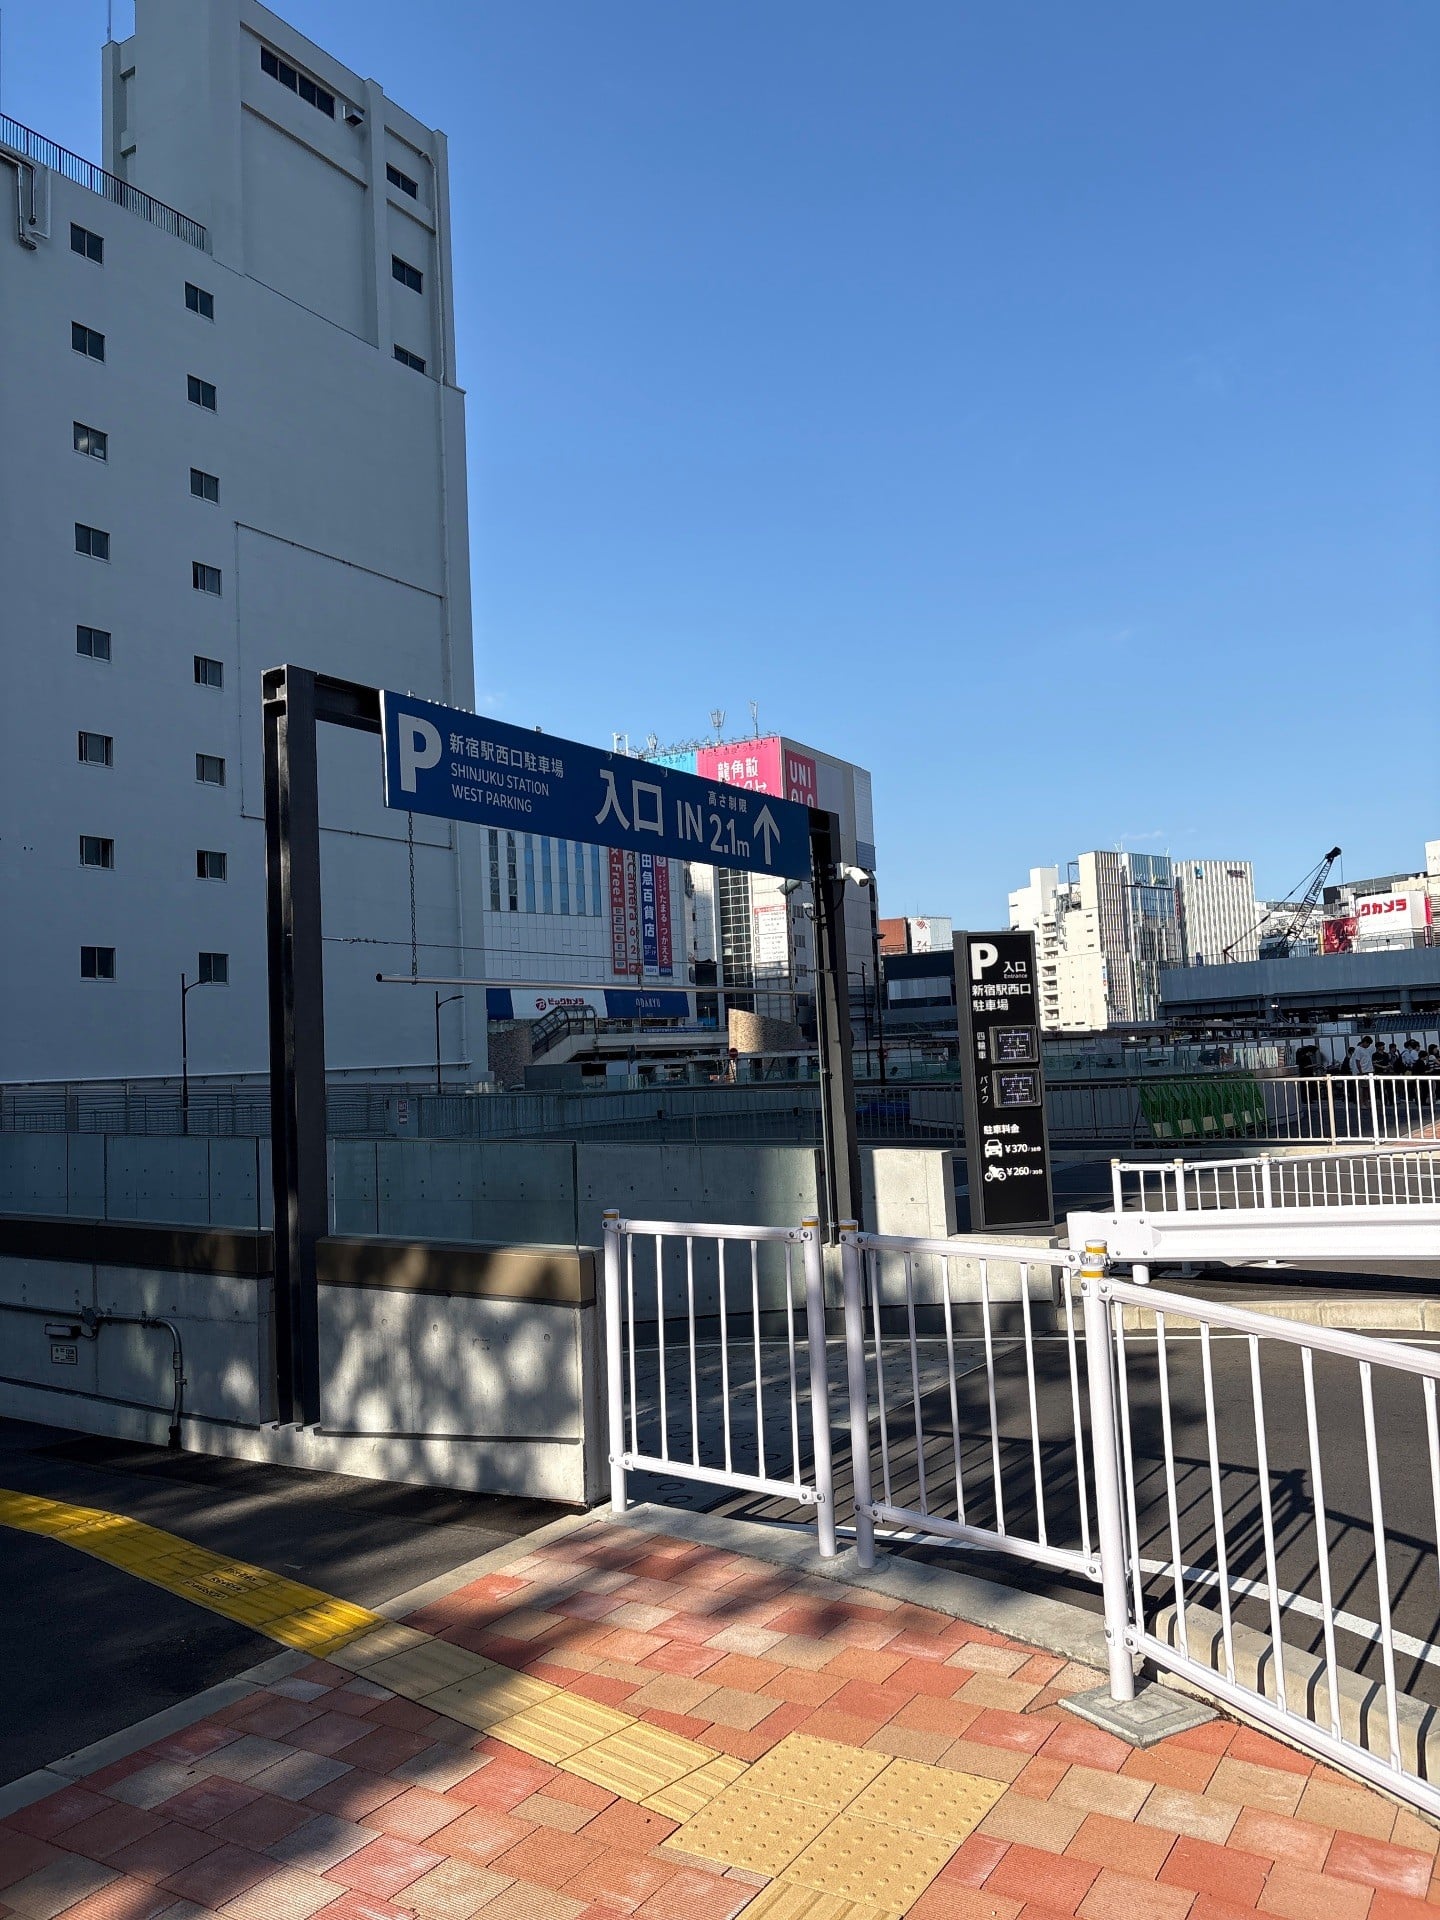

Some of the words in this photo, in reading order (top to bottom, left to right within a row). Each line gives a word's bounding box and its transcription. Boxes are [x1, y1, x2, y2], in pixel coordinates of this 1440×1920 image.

[398, 713, 442, 793] P
[449, 732, 564, 779] 新宿駅西口駐車場
[451, 762, 504, 787] SHINJUKU
[506, 775, 549, 797] STATION
[717, 757, 758, 782] 龍角散
[789, 759, 812, 788] UNI
[451, 784, 483, 803] WEST
[486, 792, 533, 813] PARKING
[594, 768, 664, 836] 入口
[707, 790, 748, 813] 高さ制限
[676, 799, 704, 843] IN
[709, 813, 750, 858] 2.1m
[970, 942, 998, 980] P
[1003, 961, 1027, 973] 入口
[971, 983, 1032, 997] 新宿駅西口
[972, 998, 1009, 1012] 駐車場
[980, 1075, 989, 1104] バイク
